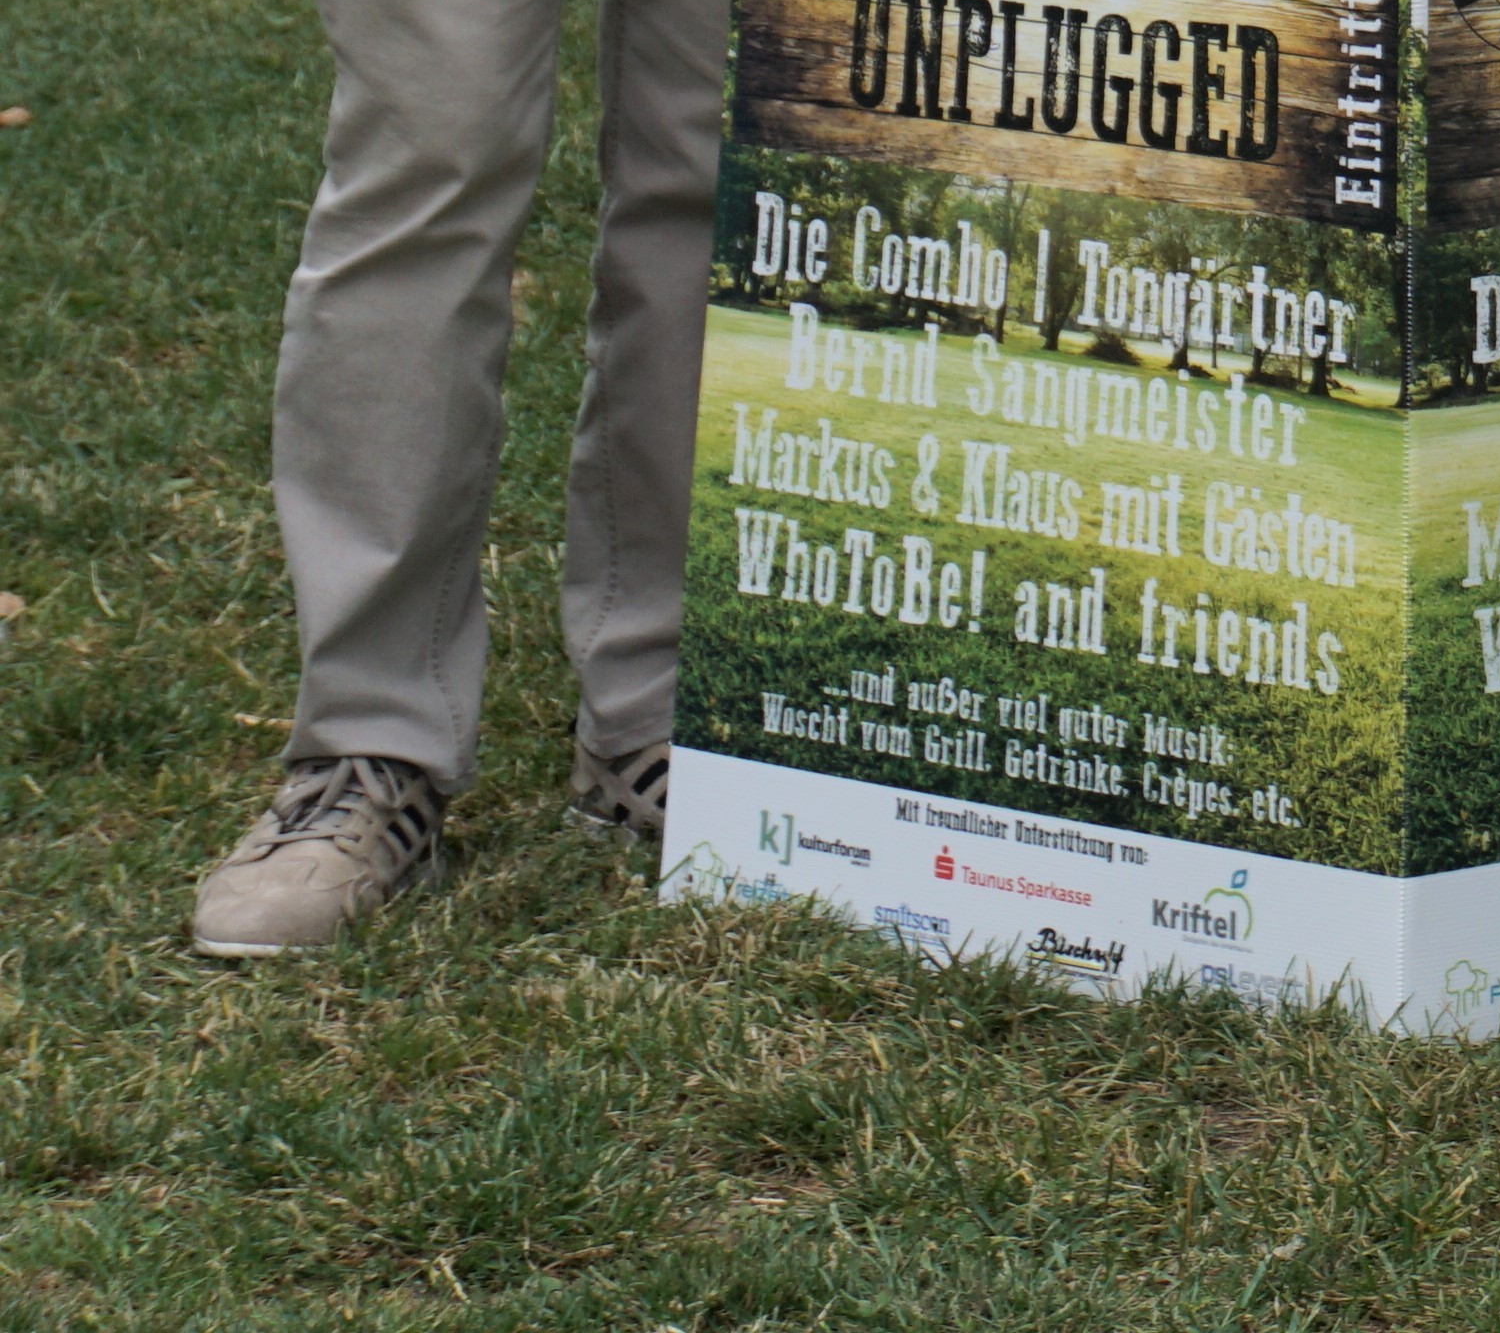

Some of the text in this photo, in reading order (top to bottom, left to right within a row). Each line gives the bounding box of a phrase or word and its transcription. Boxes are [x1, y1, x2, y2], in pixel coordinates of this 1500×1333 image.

[749, 190, 1356, 365] Die Combo Tongärtner
[784, 298, 1305, 472] Bernd Sangmeister
[728, 500, 1341, 701] WhoToBe! and friends
[895, 796, 1147, 867] Mit freundlicher Unterstützung von:
[1152, 894, 1236, 944] Kriftel
